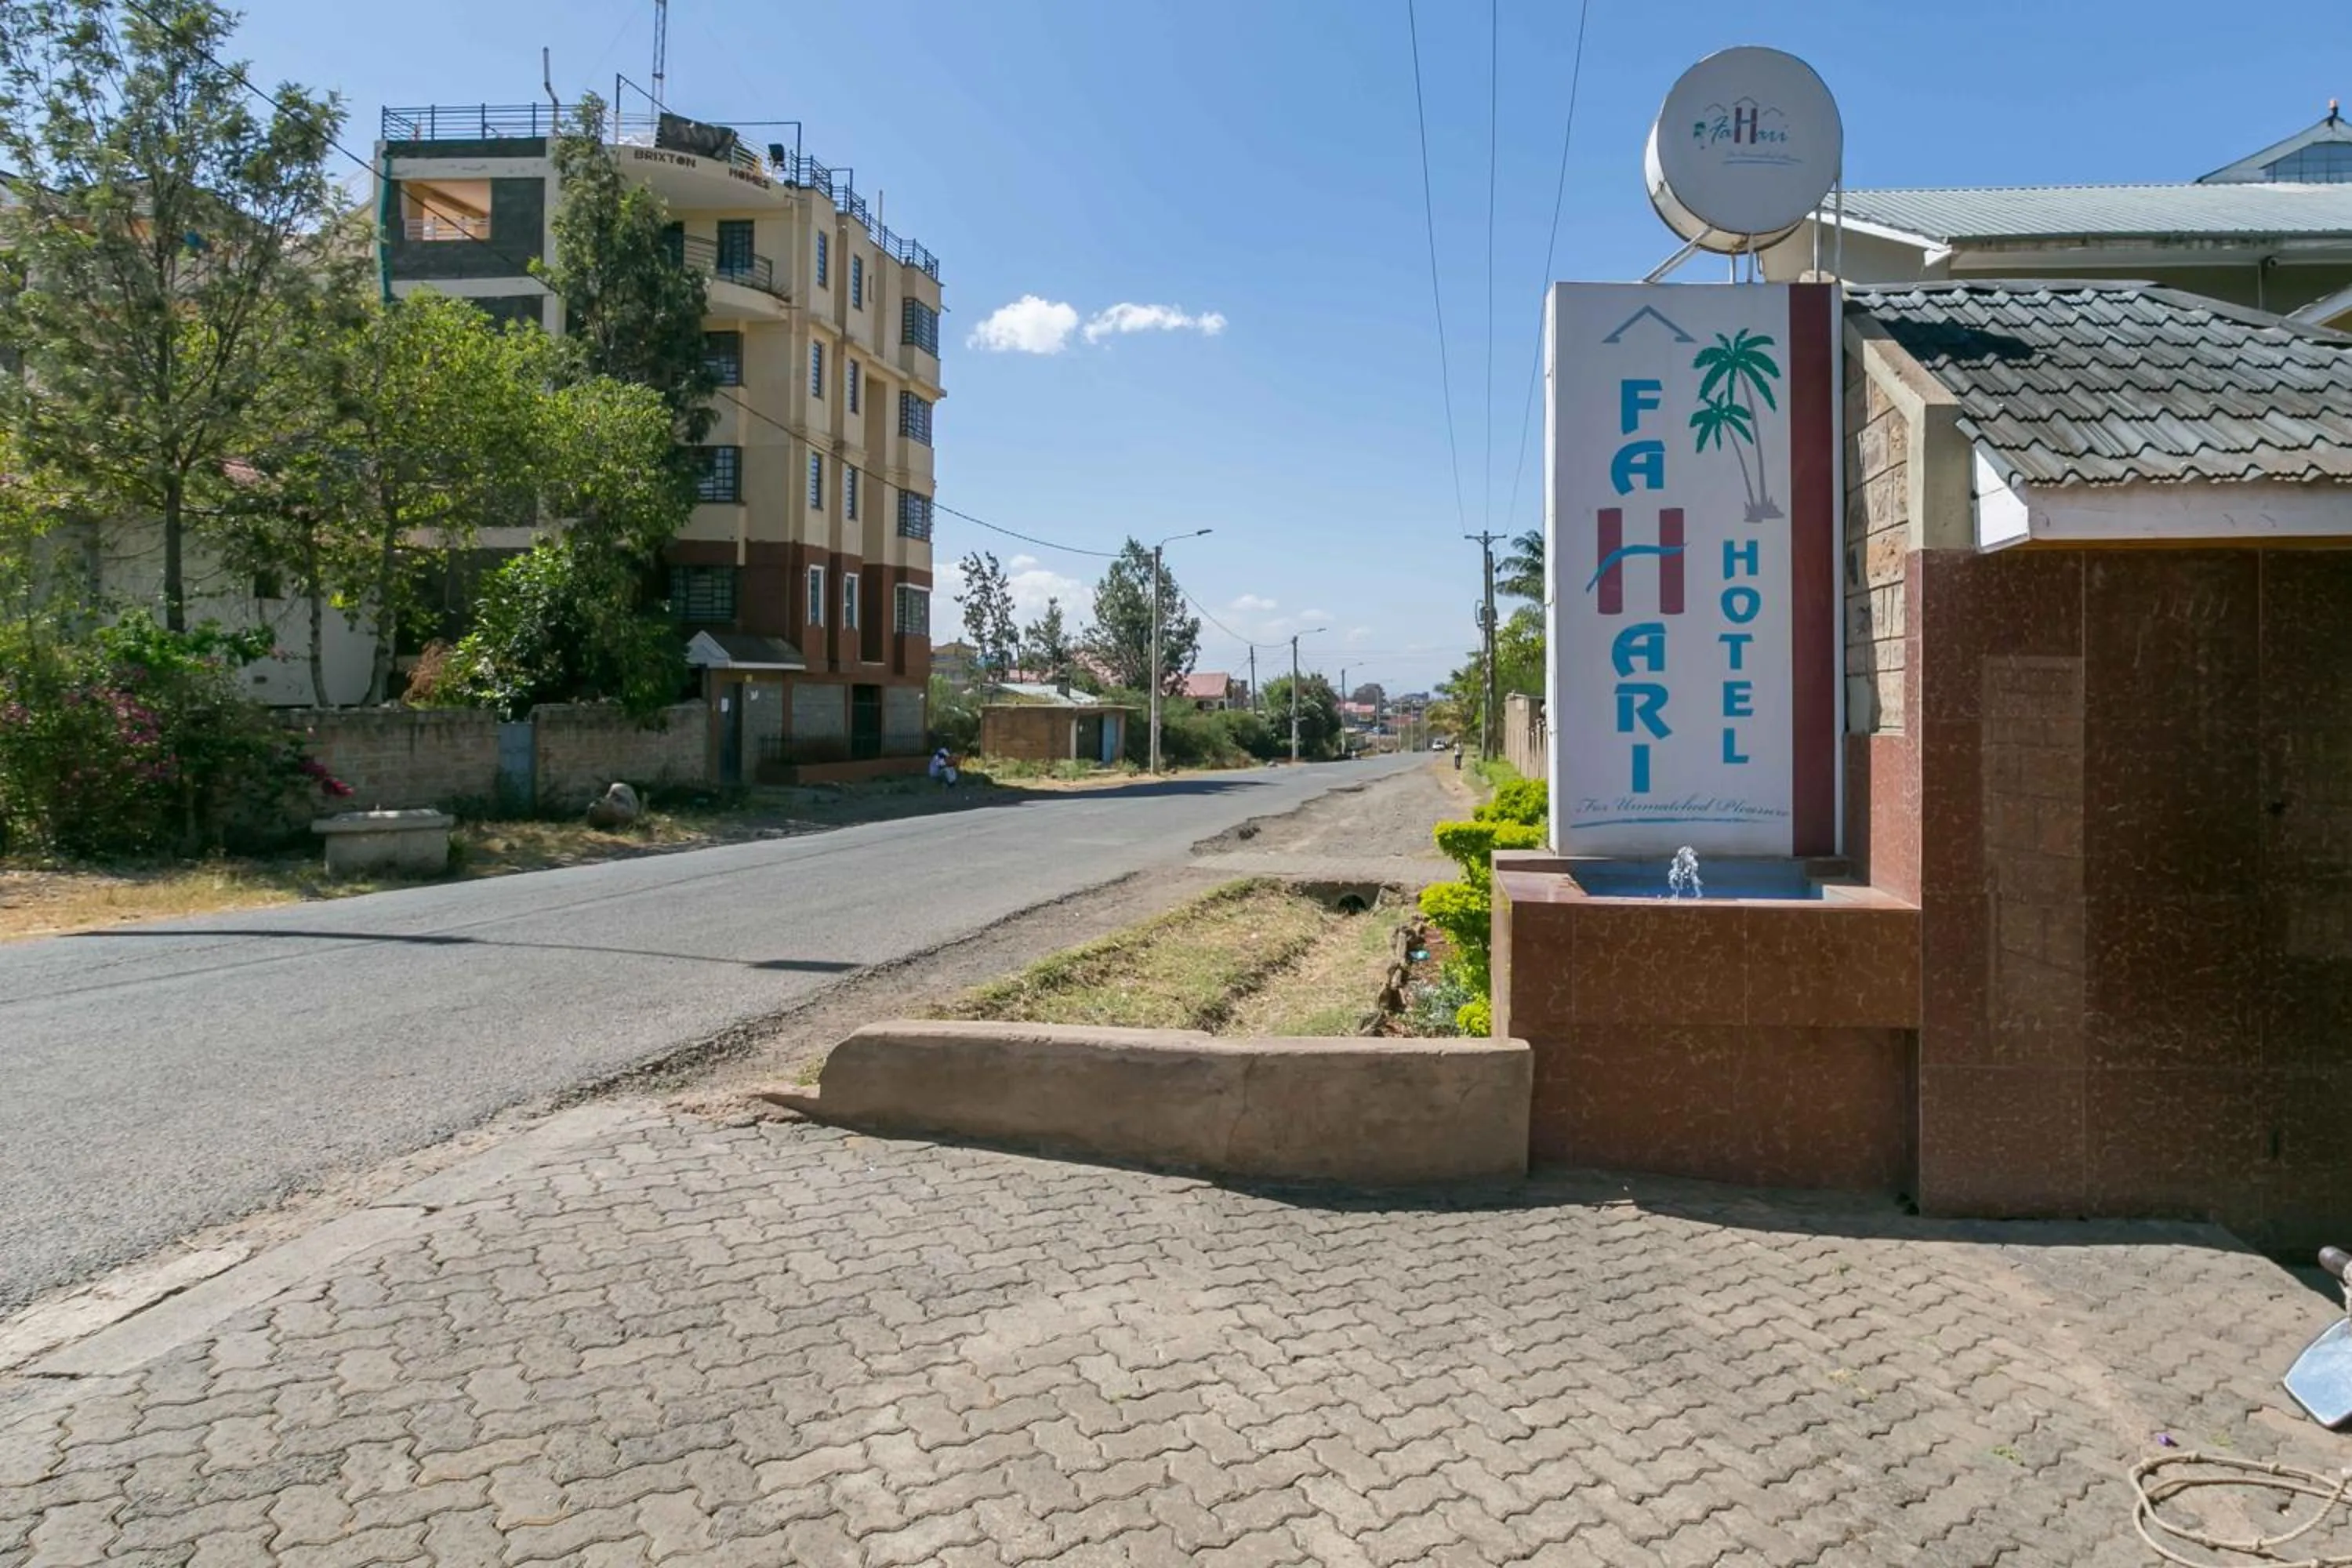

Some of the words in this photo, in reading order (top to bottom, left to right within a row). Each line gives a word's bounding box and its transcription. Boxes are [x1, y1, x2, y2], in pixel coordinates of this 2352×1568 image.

[634, 150, 696, 169] BRIXTON
[1587, 379, 1688, 793] FAHARI
[1719, 539, 1761, 764] HOTEL
[1576, 798, 1608, 814] For
[1617, 793, 1716, 812] Unmatched
